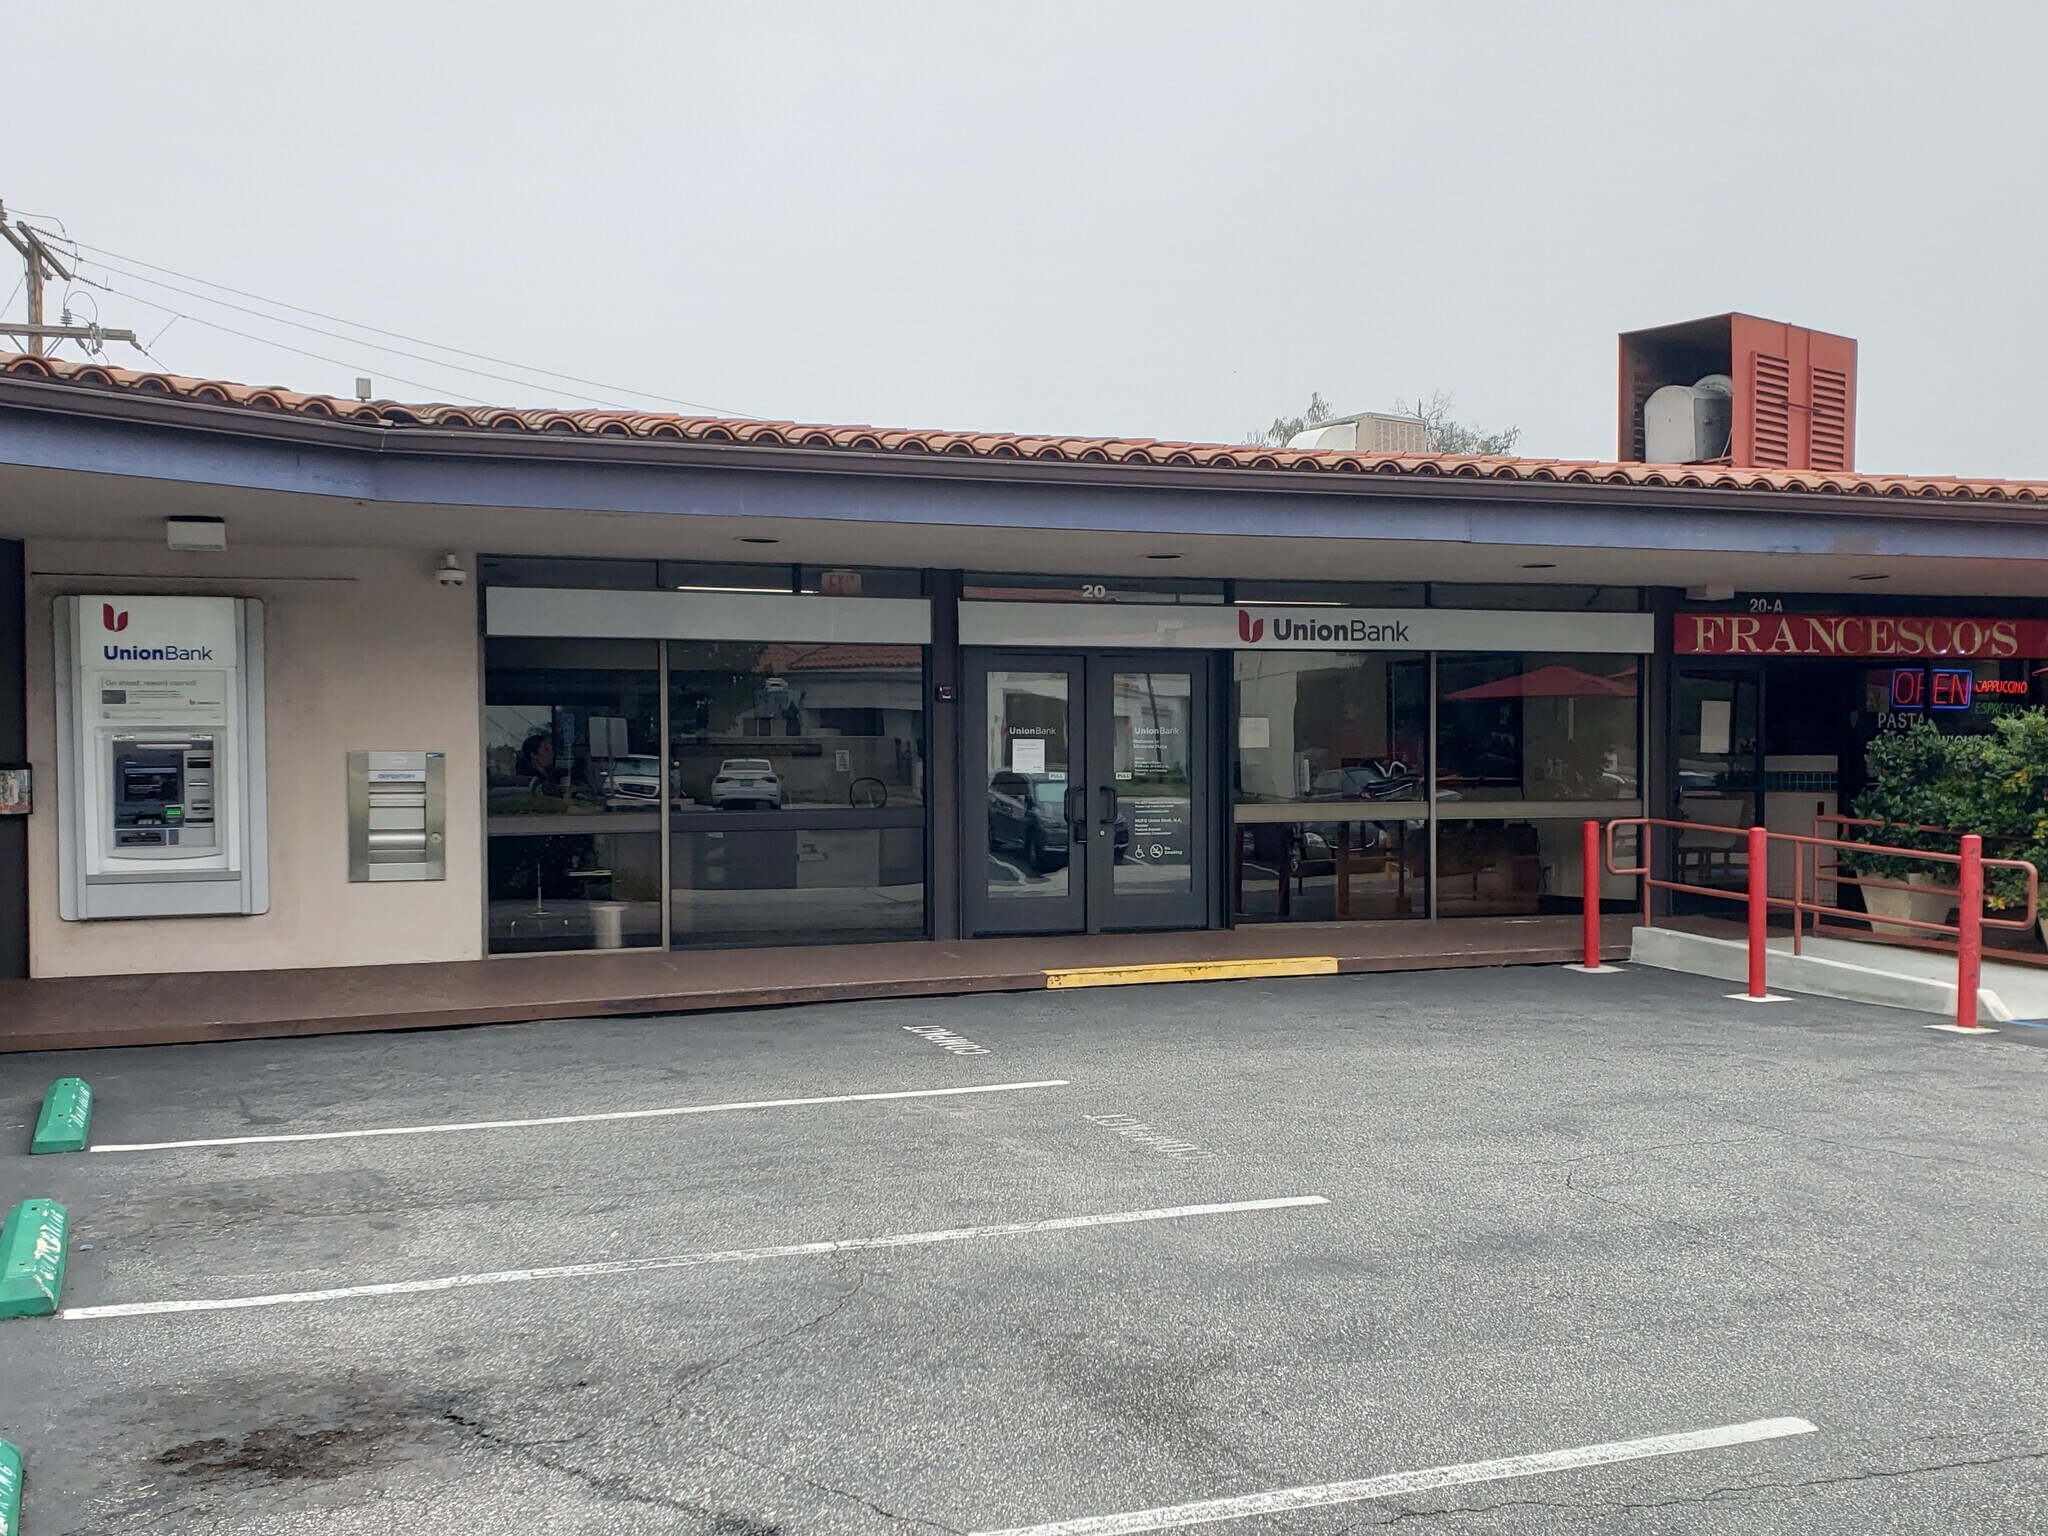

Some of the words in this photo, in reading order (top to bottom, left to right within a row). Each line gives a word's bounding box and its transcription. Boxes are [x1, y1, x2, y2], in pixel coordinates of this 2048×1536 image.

[1081, 584, 1106, 598] 20
[1750, 598, 1783, 613] 20-A
[1273, 618, 1410, 642] UnionBank
[1690, 616, 2018, 657] FRANCESCO'S
[103, 645, 213, 661] UnionBank
[1974, 680, 2028, 694] CAPPUCCINO
[1974, 702, 2022, 715] ESPRESSO
[1877, 712, 1925, 729] PASTA
[1009, 726, 1057, 735] UnionBank
[1134, 726, 1180, 735] UnionBank
[901, 1024, 991, 1056] COMPACT
